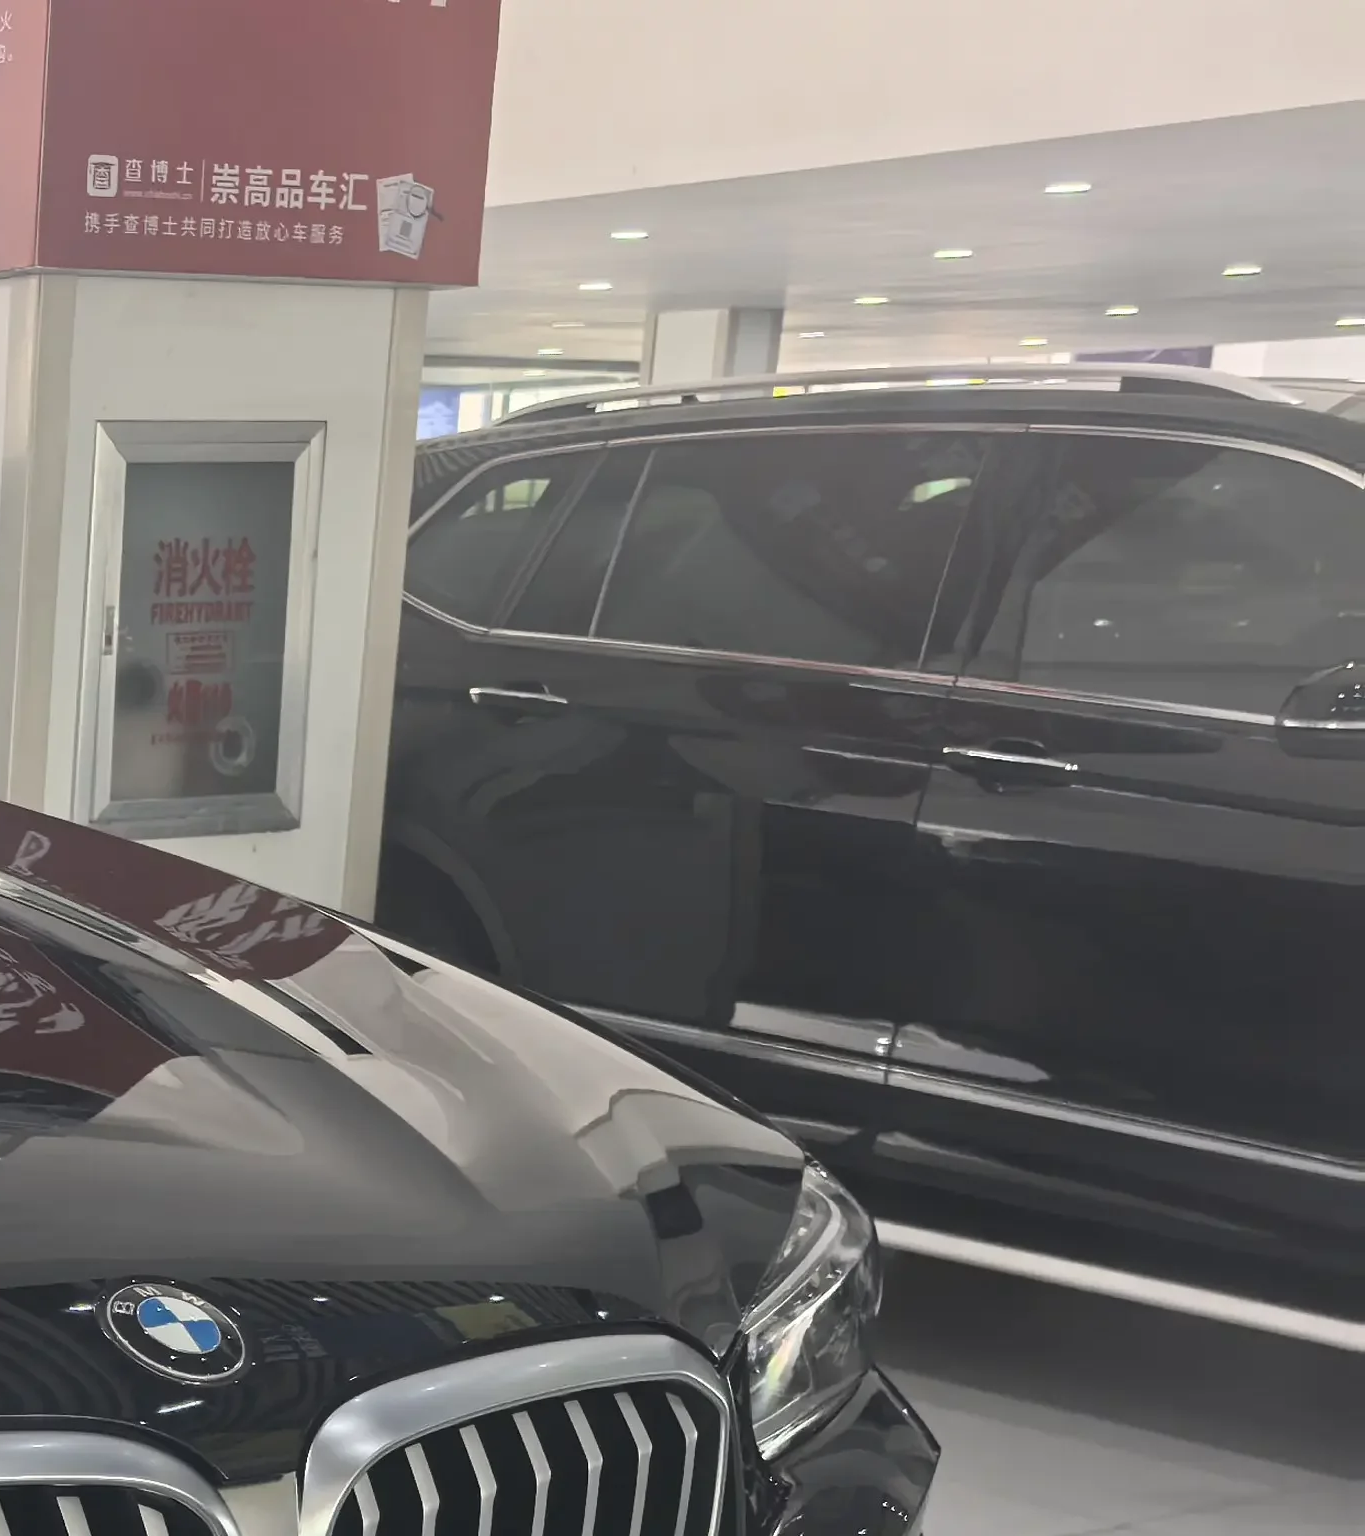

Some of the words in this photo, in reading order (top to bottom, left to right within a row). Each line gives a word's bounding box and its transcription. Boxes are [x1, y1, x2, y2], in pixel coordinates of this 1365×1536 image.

[210, 163, 369, 212] 崇高品车汇
[83, 211, 345, 246] 携手查博士共同打造放心车服务
[153, 536, 257, 598] 消火栓
[112, 1285, 207, 1316] BMW
